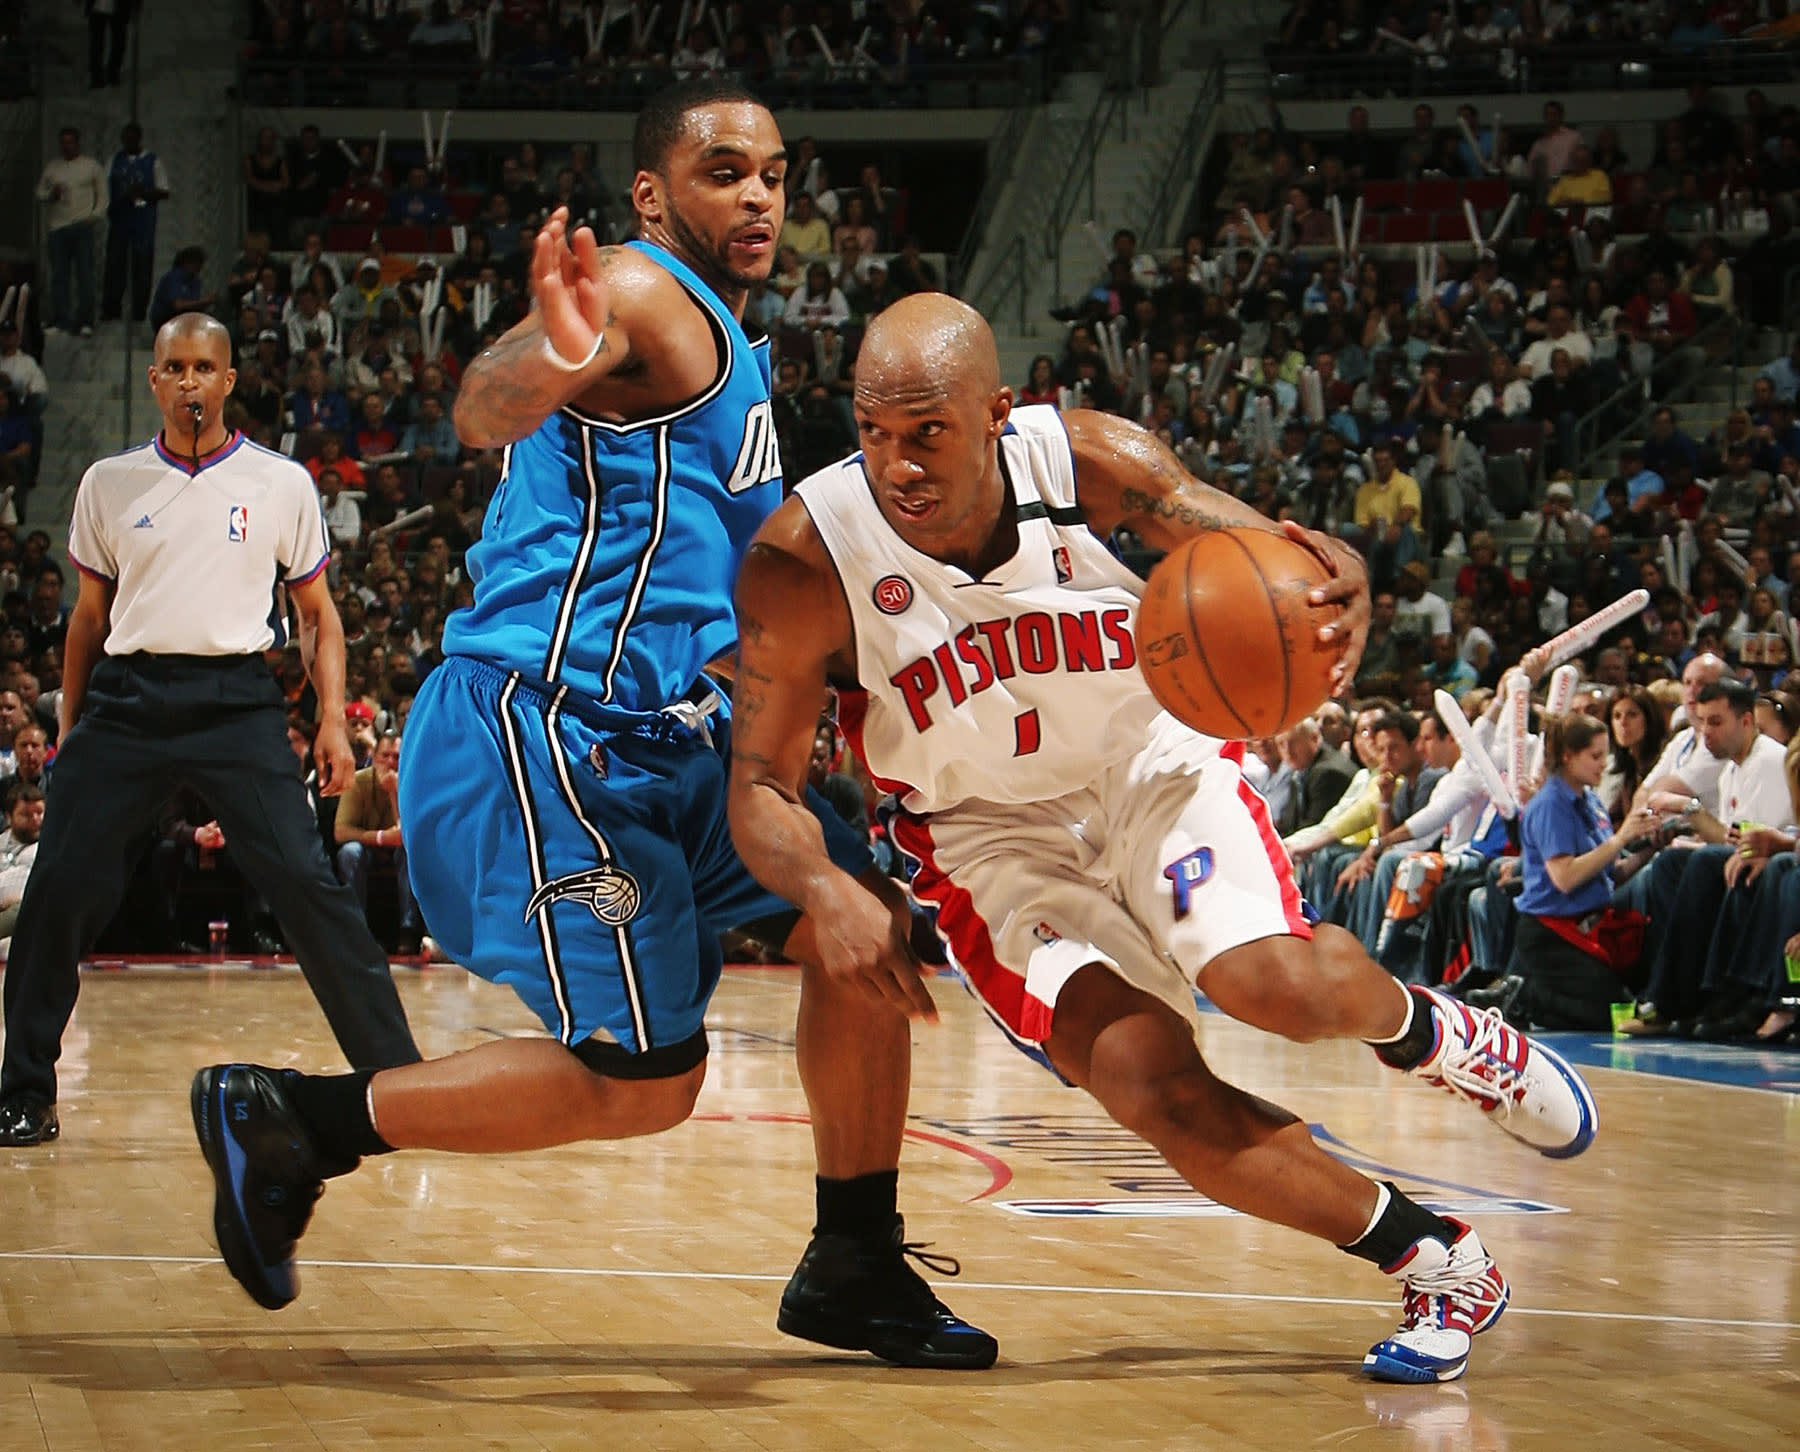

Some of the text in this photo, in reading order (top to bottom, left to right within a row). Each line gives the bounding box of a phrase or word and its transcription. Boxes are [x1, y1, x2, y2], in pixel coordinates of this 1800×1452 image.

[882, 585, 905, 605] 50
[889, 608, 1137, 735] PISTONS
[1013, 708, 1041, 757] 1
[1163, 846, 1216, 922] P
